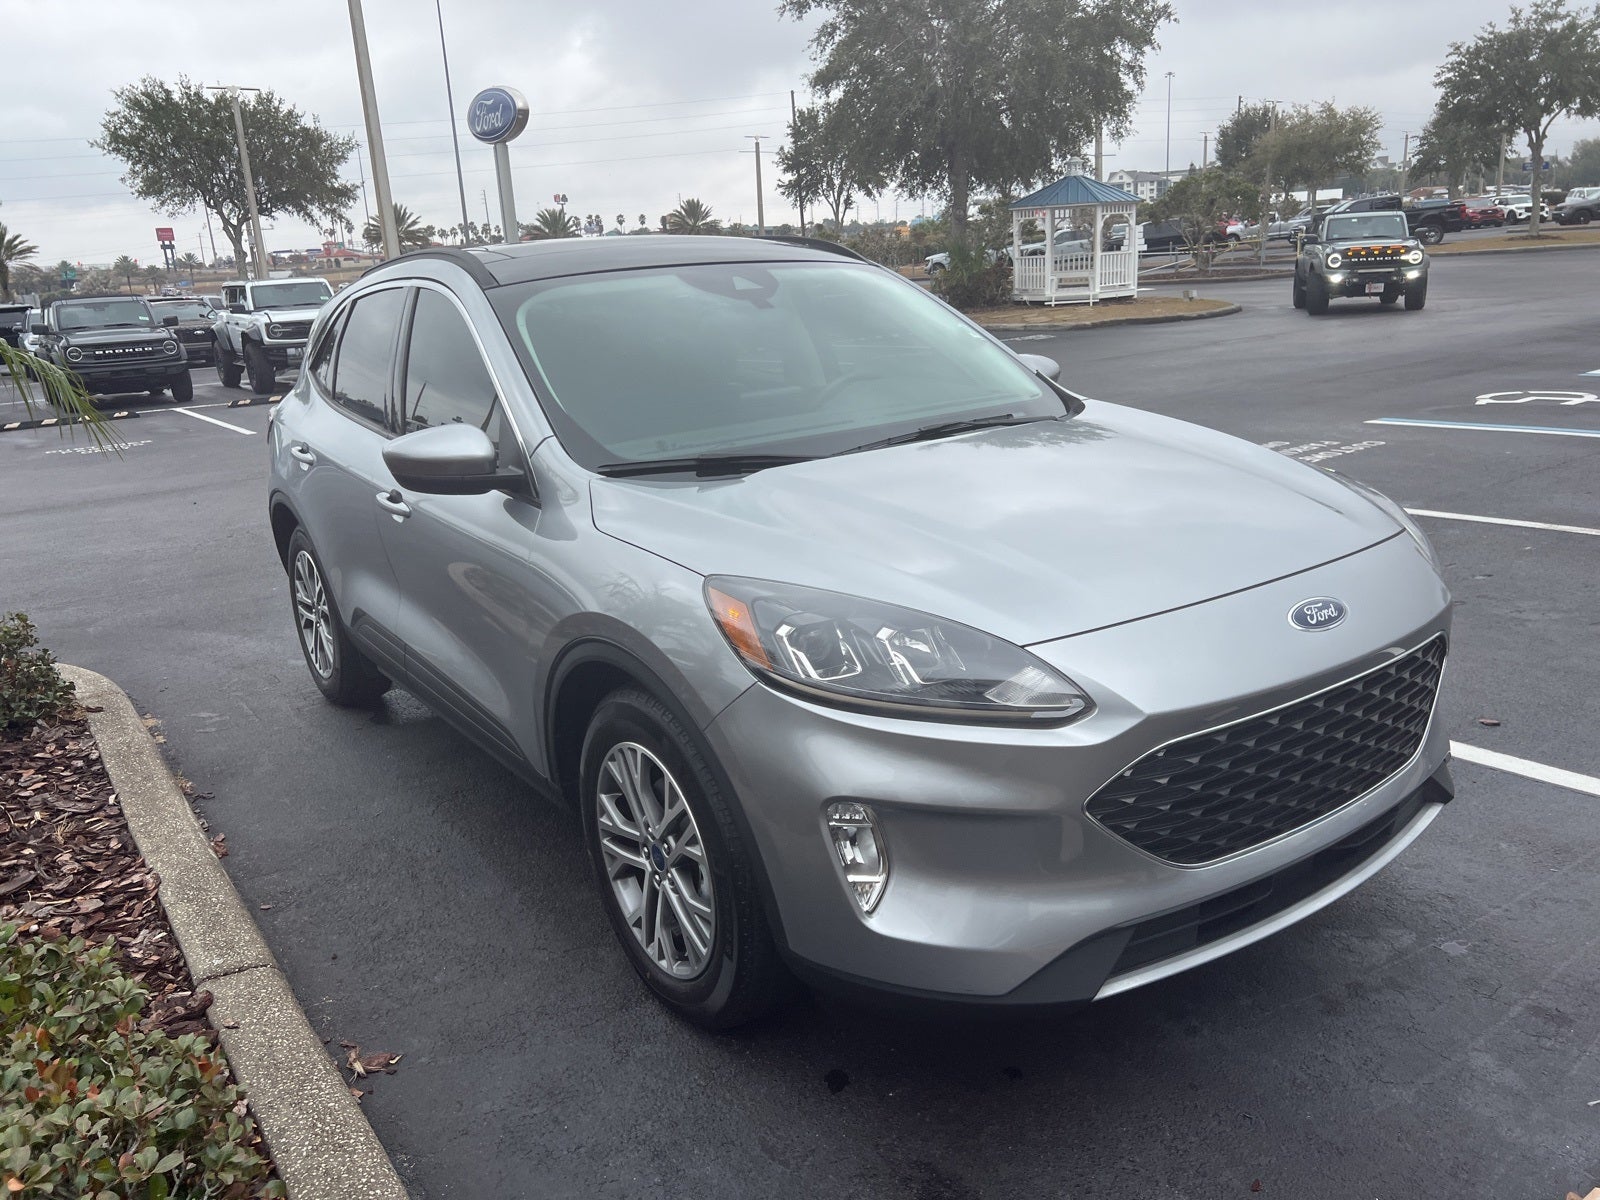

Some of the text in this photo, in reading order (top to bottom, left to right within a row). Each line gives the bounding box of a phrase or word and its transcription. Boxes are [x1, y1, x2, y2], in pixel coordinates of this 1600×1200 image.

[475, 98, 503, 132] Ford
[94, 346, 153, 355] BRONCO
[1304, 602, 1338, 624] Ford
